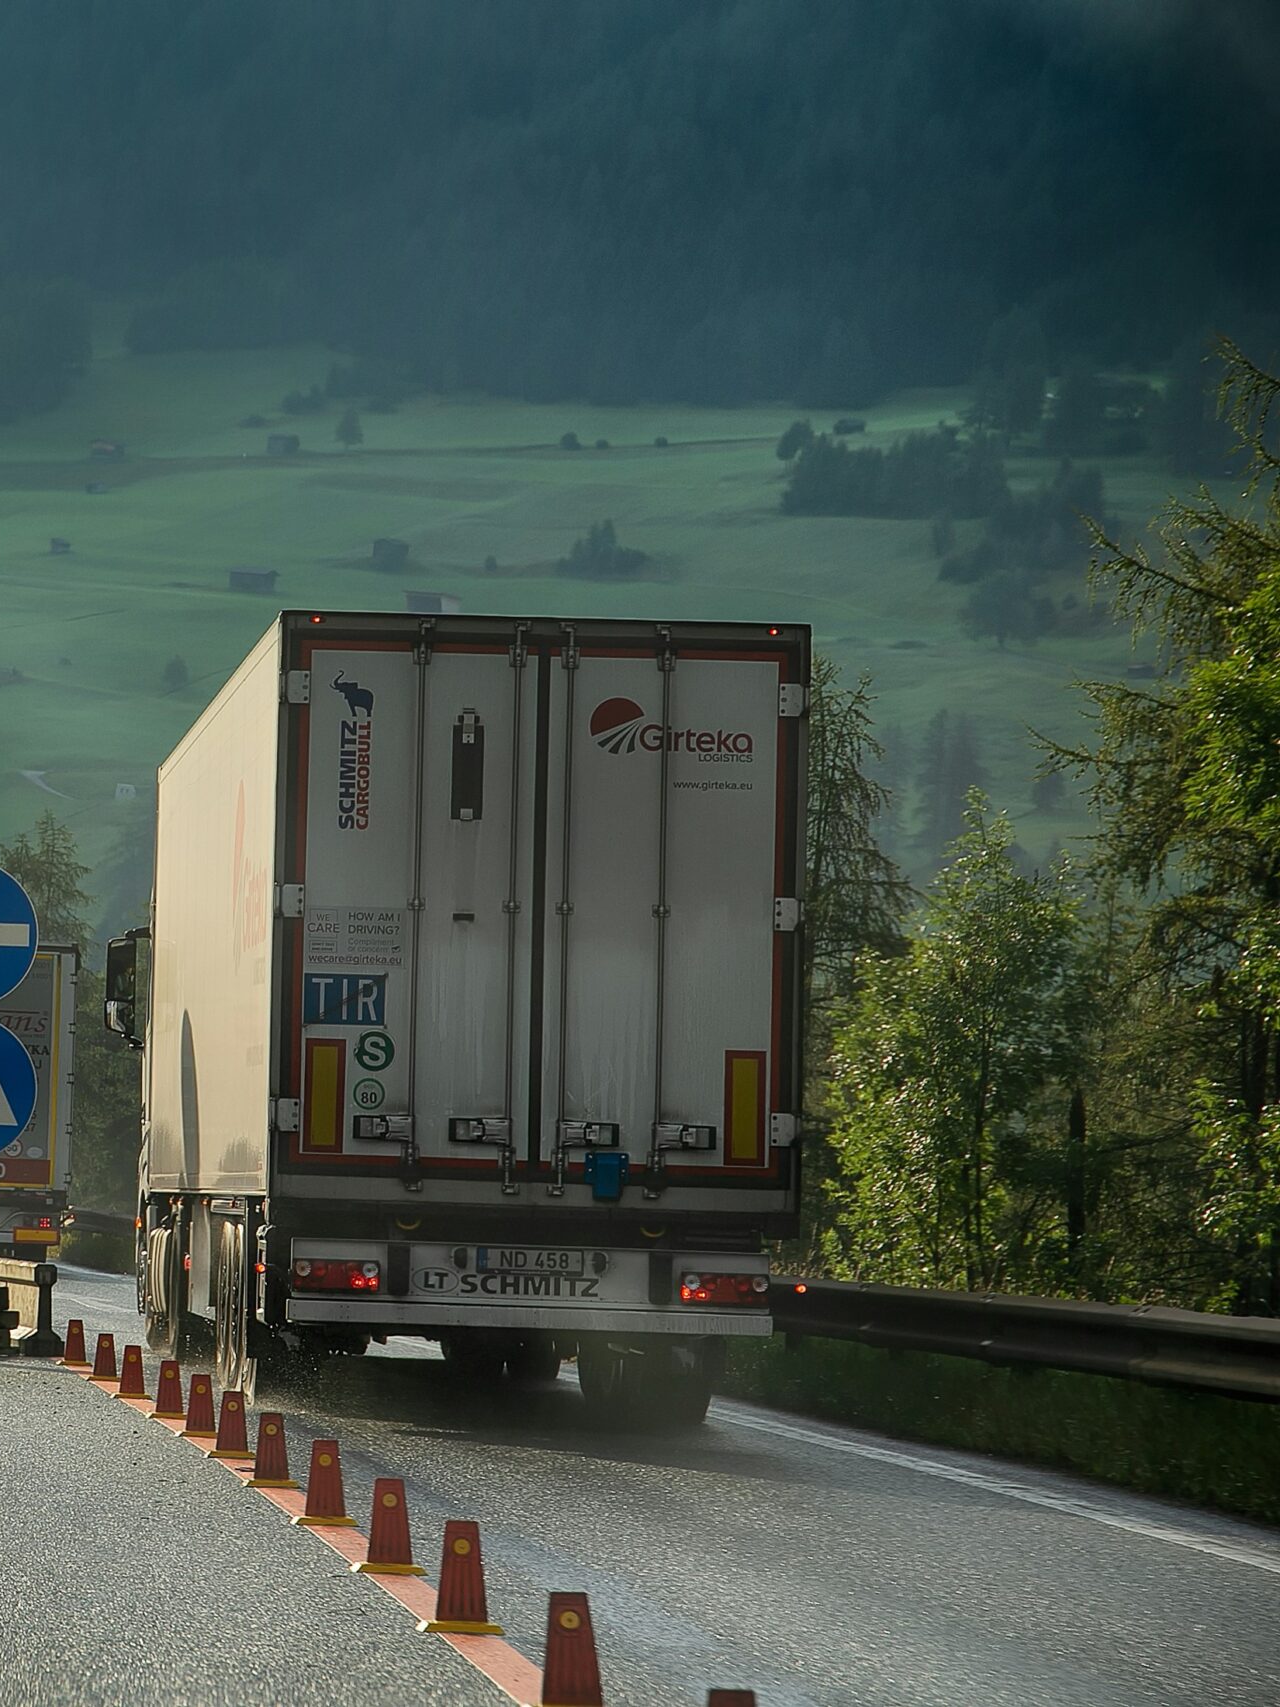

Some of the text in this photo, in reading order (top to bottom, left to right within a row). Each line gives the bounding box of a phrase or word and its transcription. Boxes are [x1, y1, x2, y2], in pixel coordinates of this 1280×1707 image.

[639, 724, 753, 754] Girteka
[698, 754, 753, 763] LOGISTICS
[339, 720, 357, 830] SCHMITZ
[357, 720, 372, 830] CARGOBULL
[673, 780, 753, 791] www.girteka.eu
[316, 913, 331, 921] WE
[348, 912, 373, 921] HOW
[377, 913, 394, 922] AM
[307, 922, 340, 934] CARE
[348, 925, 400, 935] DRIVING?
[312, 978, 378, 1021] TIR
[362, 1036, 386, 1067] S
[360, 1092, 377, 1104] 80
[500, 1250, 570, 1270] ND 458
[424, 1271, 600, 1297] LT SCHMITZ
